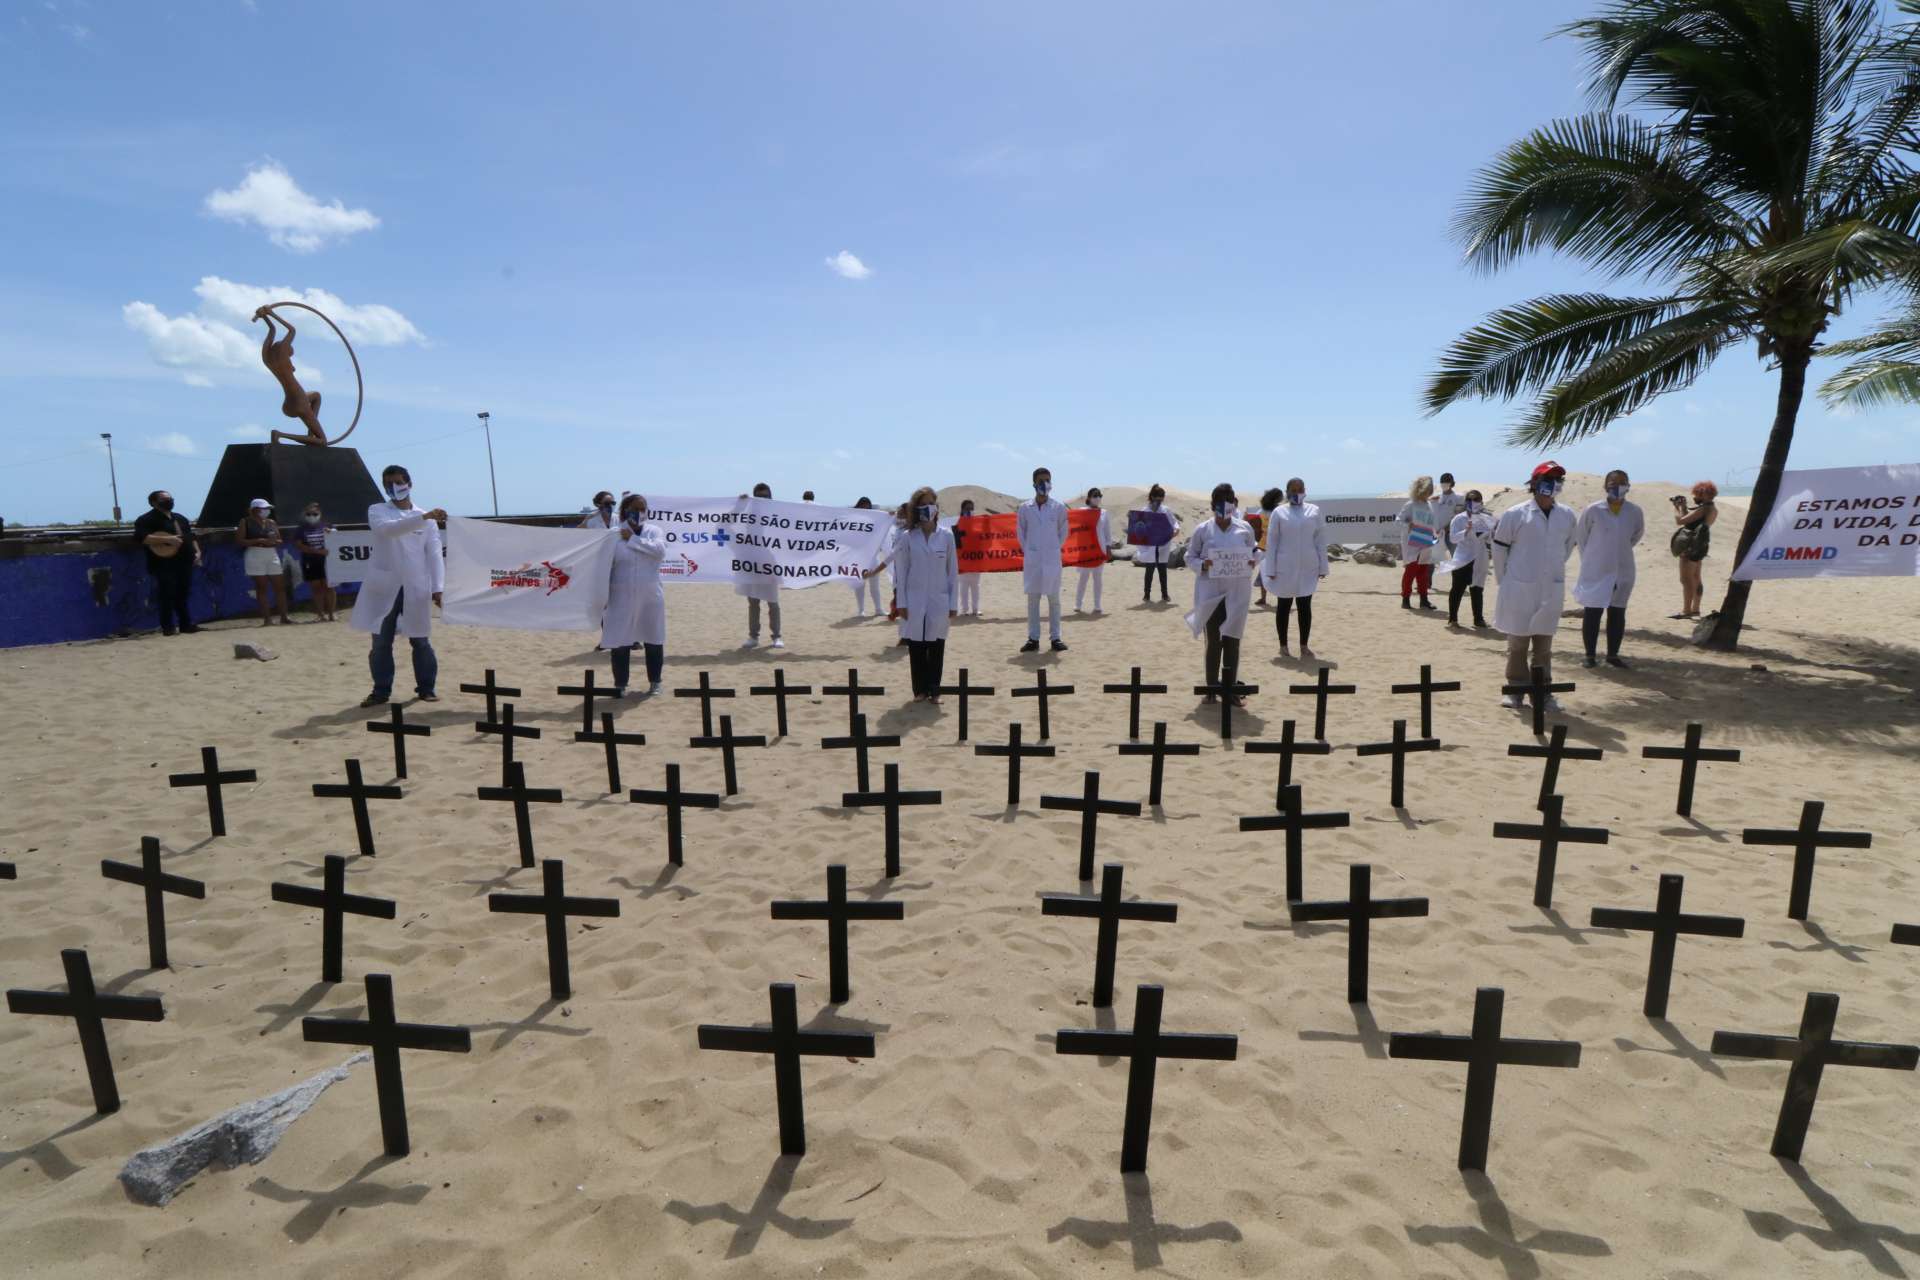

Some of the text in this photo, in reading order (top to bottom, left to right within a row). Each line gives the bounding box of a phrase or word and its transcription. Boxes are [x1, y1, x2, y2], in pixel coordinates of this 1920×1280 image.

[1796, 496, 1906, 513] ESTAMOS
[647, 510, 874, 533] UITAS MORTES SÃO EVITÁVEIS
[1325, 513, 1396, 524] Ciência e pel
[1794, 514, 1920, 530] DA VIDA, D
[666, 532, 840, 552] O SUS SALVA VIDAS,
[1857, 533, 1920, 547] DA D
[339, 545, 373, 561] SU
[1756, 547, 1838, 560] ABMMD
[732, 559, 832, 577] BOLSONARO
